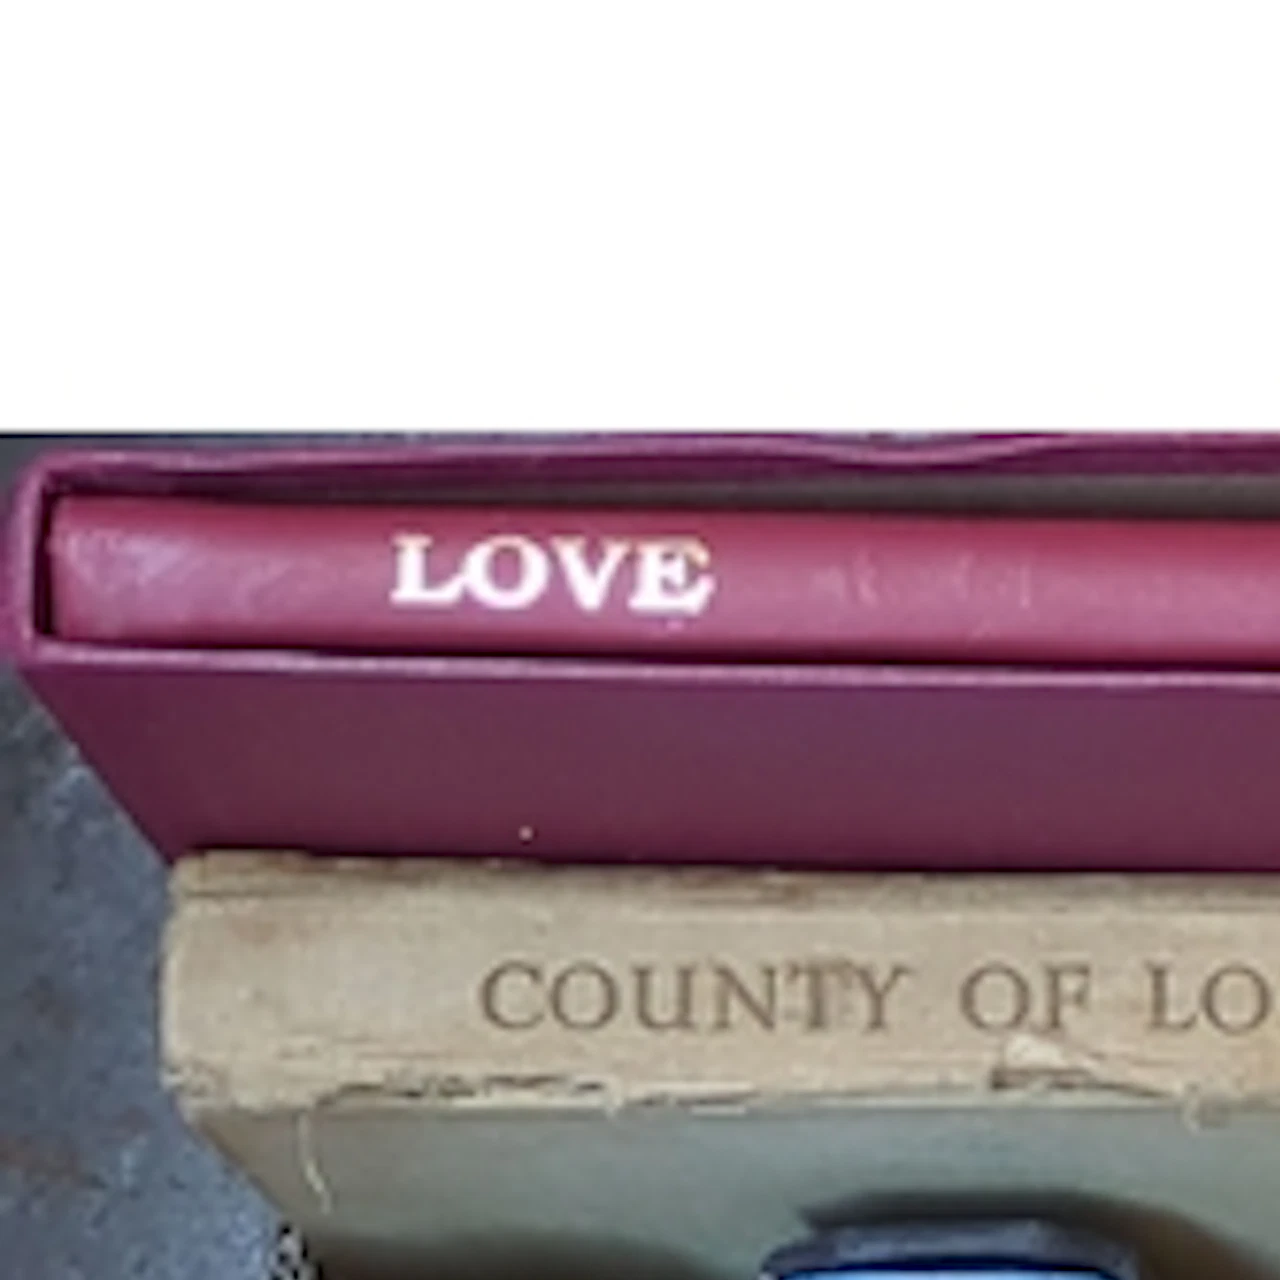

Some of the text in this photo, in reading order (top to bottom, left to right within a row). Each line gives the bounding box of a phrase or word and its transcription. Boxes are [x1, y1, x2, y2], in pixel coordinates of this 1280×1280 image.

[391, 534, 714, 616] LOVE
[477, 960, 907, 1032] COUNTY
[958, 966, 1095, 1032] OF
